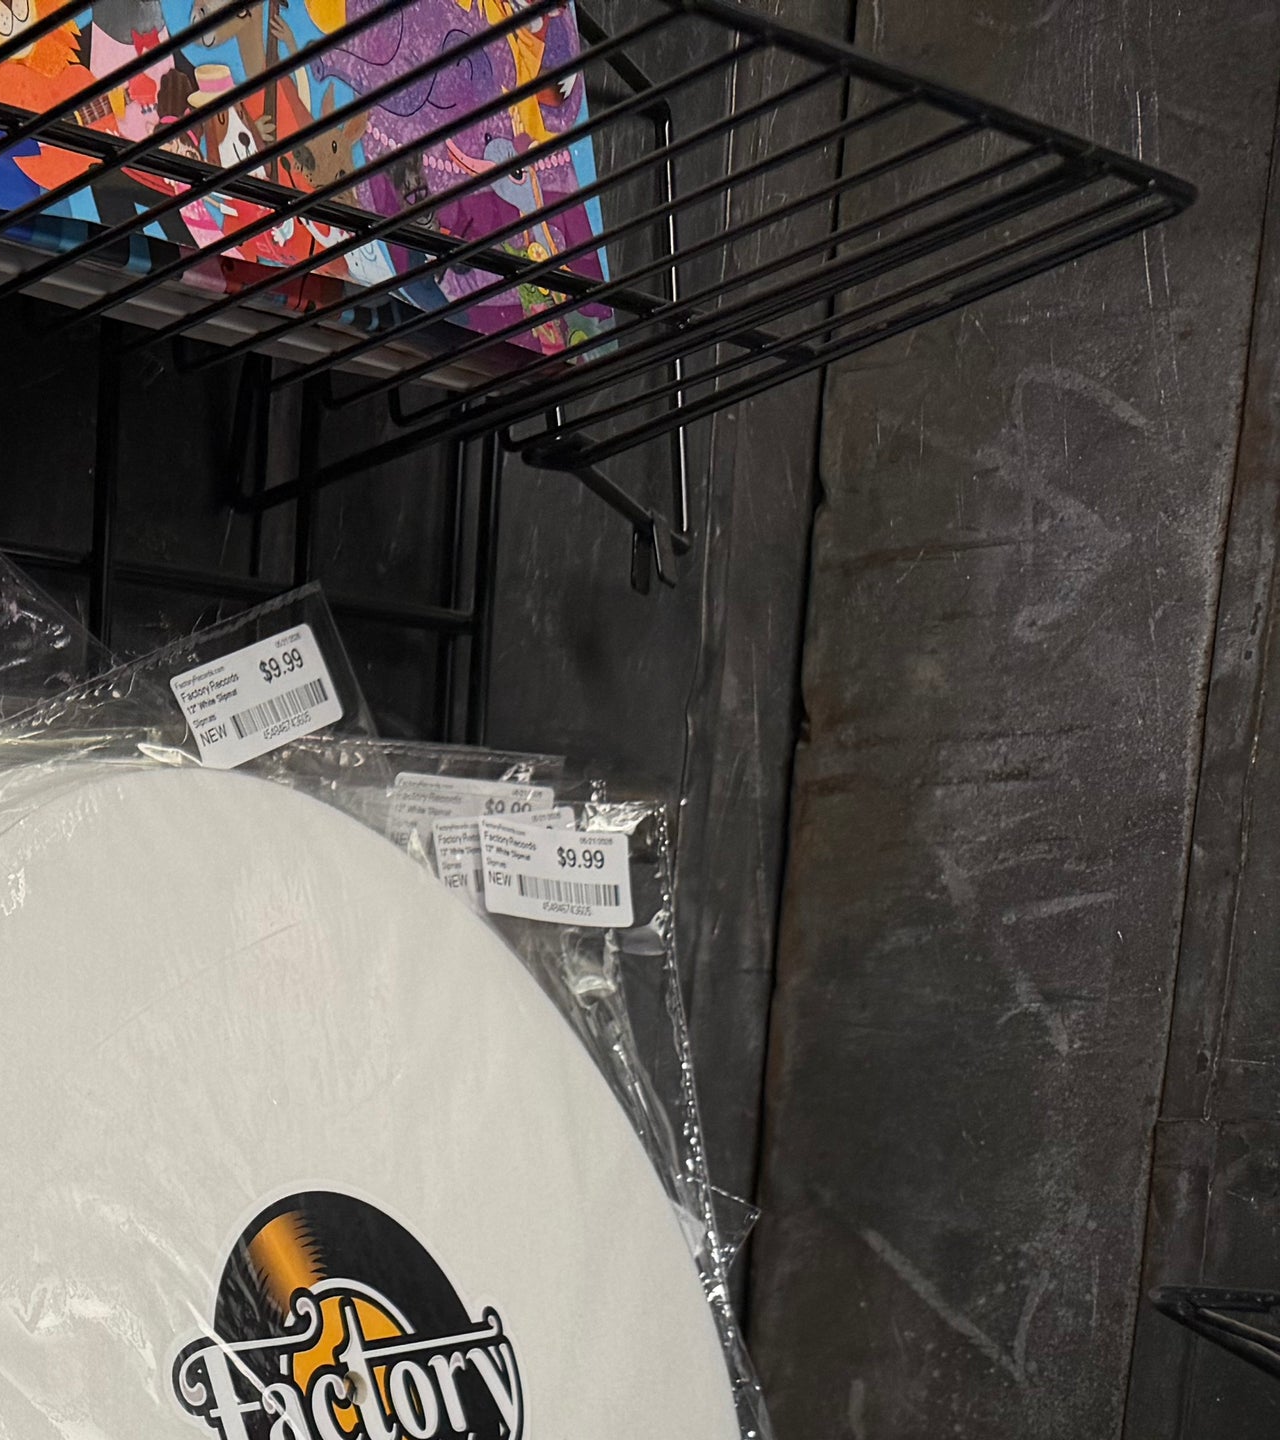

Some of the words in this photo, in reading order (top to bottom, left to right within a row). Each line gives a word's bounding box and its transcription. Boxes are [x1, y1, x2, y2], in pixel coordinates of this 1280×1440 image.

[259, 648, 304, 684] $9.99
[180, 685, 210, 703] Factory
[209, 673, 239, 691] Records
[200, 723, 228, 747] NEW
[484, 797, 532, 816] $999
[557, 846, 605, 869] $9.99
[444, 873, 468, 888] NEW
[487, 870, 512, 887] NEW
